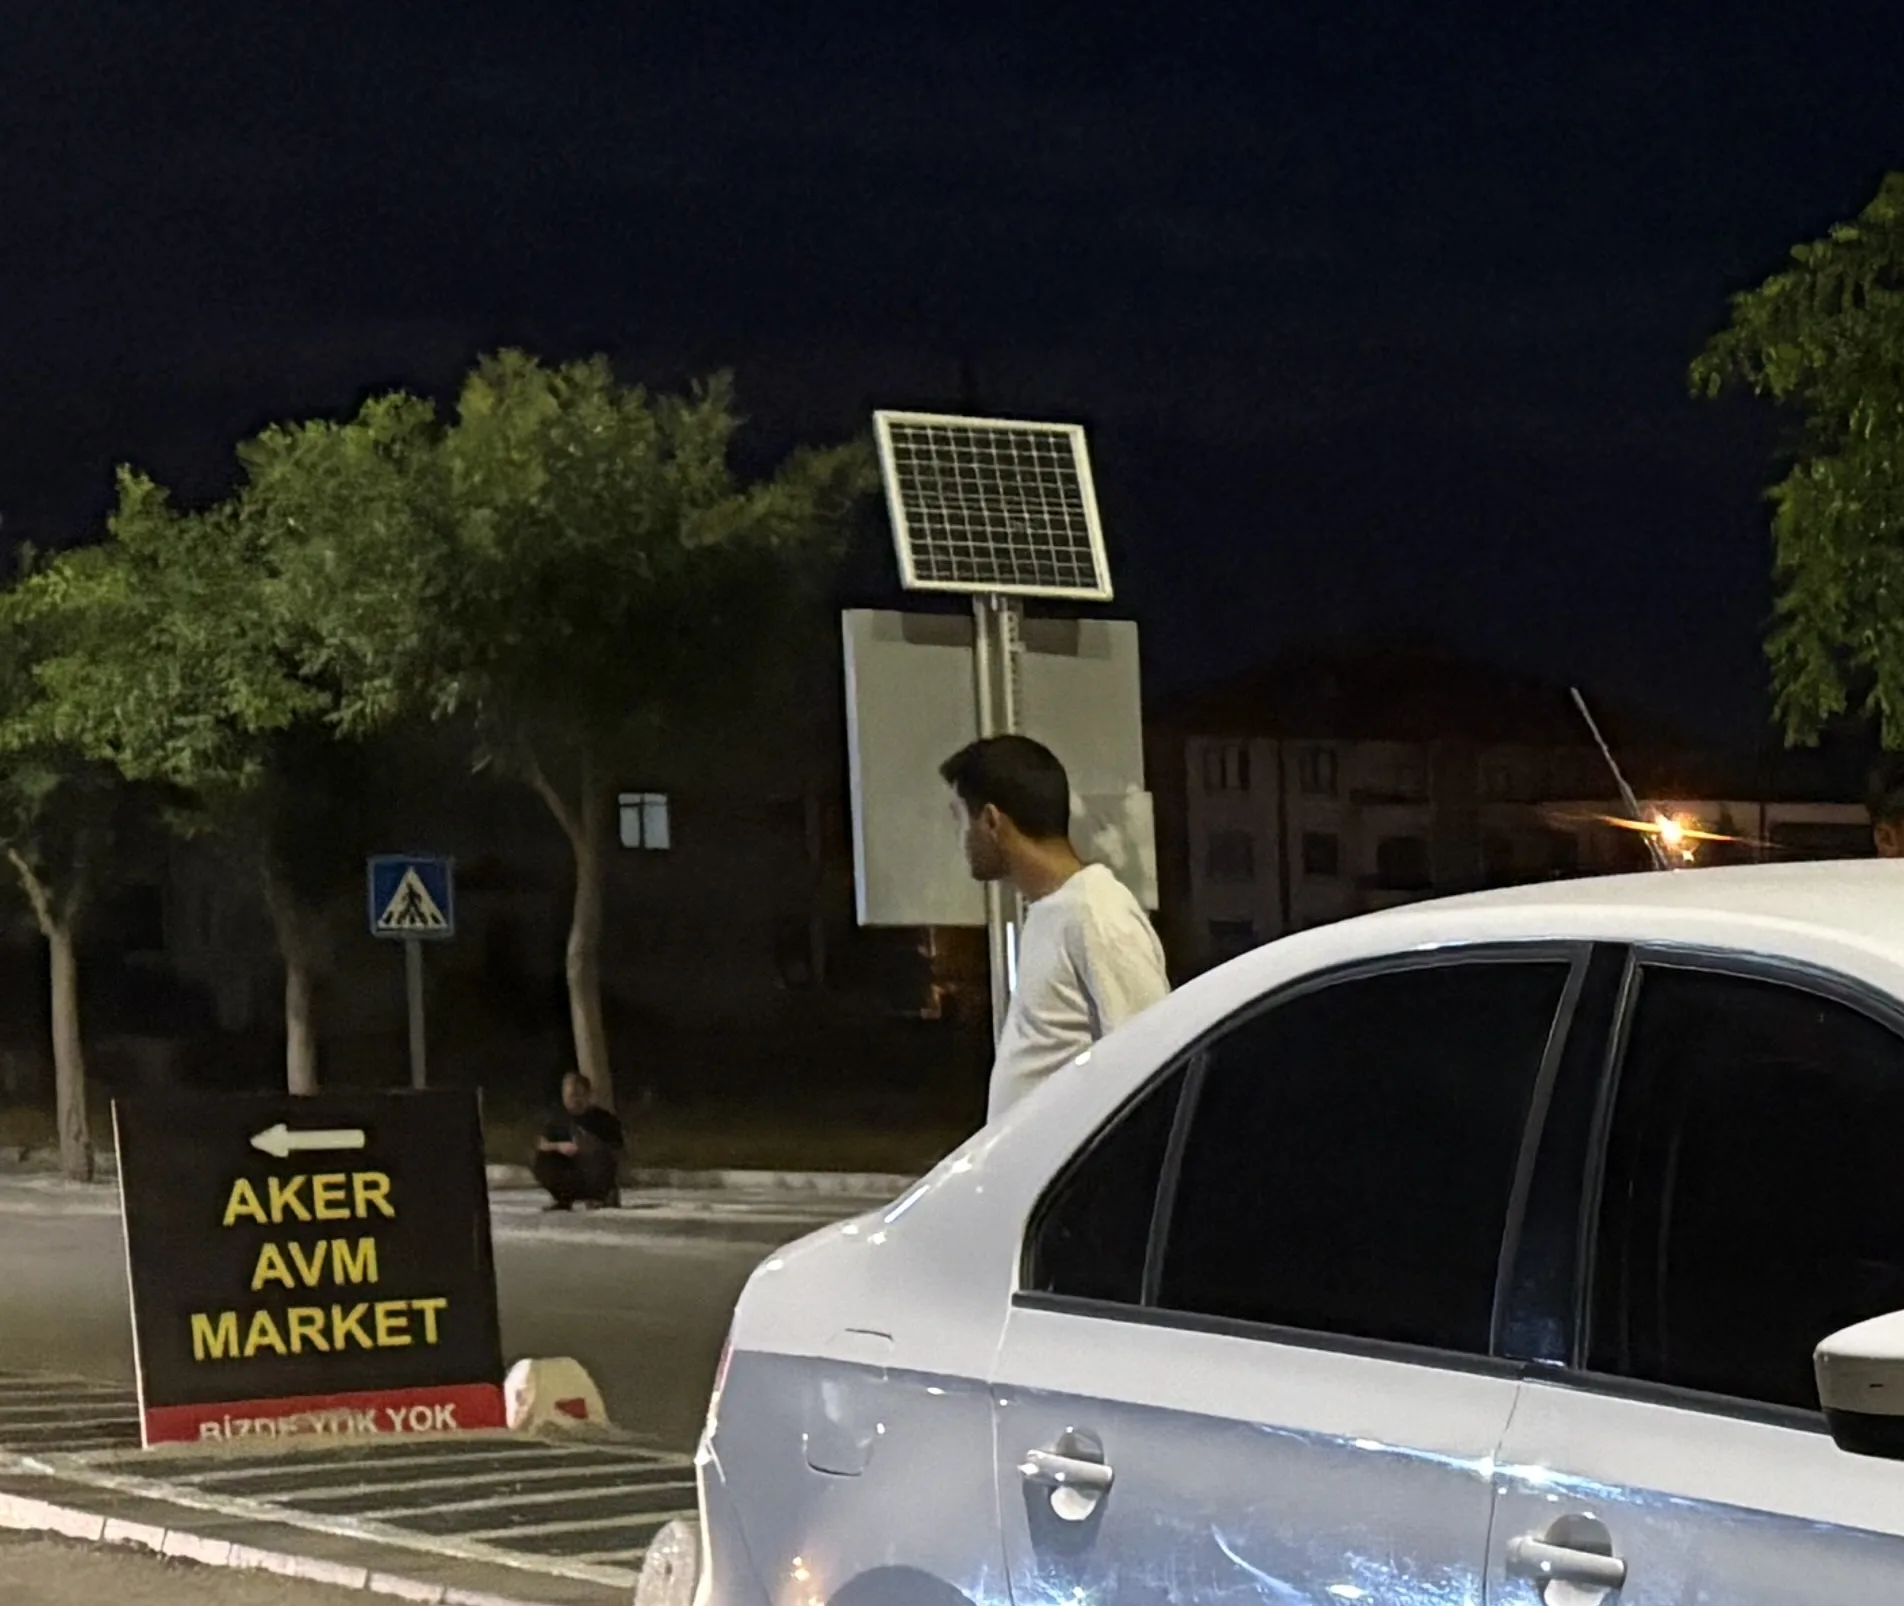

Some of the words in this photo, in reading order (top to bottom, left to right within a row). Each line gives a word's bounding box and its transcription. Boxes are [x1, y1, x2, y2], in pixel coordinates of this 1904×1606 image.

[222, 1171, 395, 1226] AKER
[250, 1237, 379, 1291] AVM
[190, 1298, 447, 1361] MARKET
[385, 1403, 457, 1432] YOK
